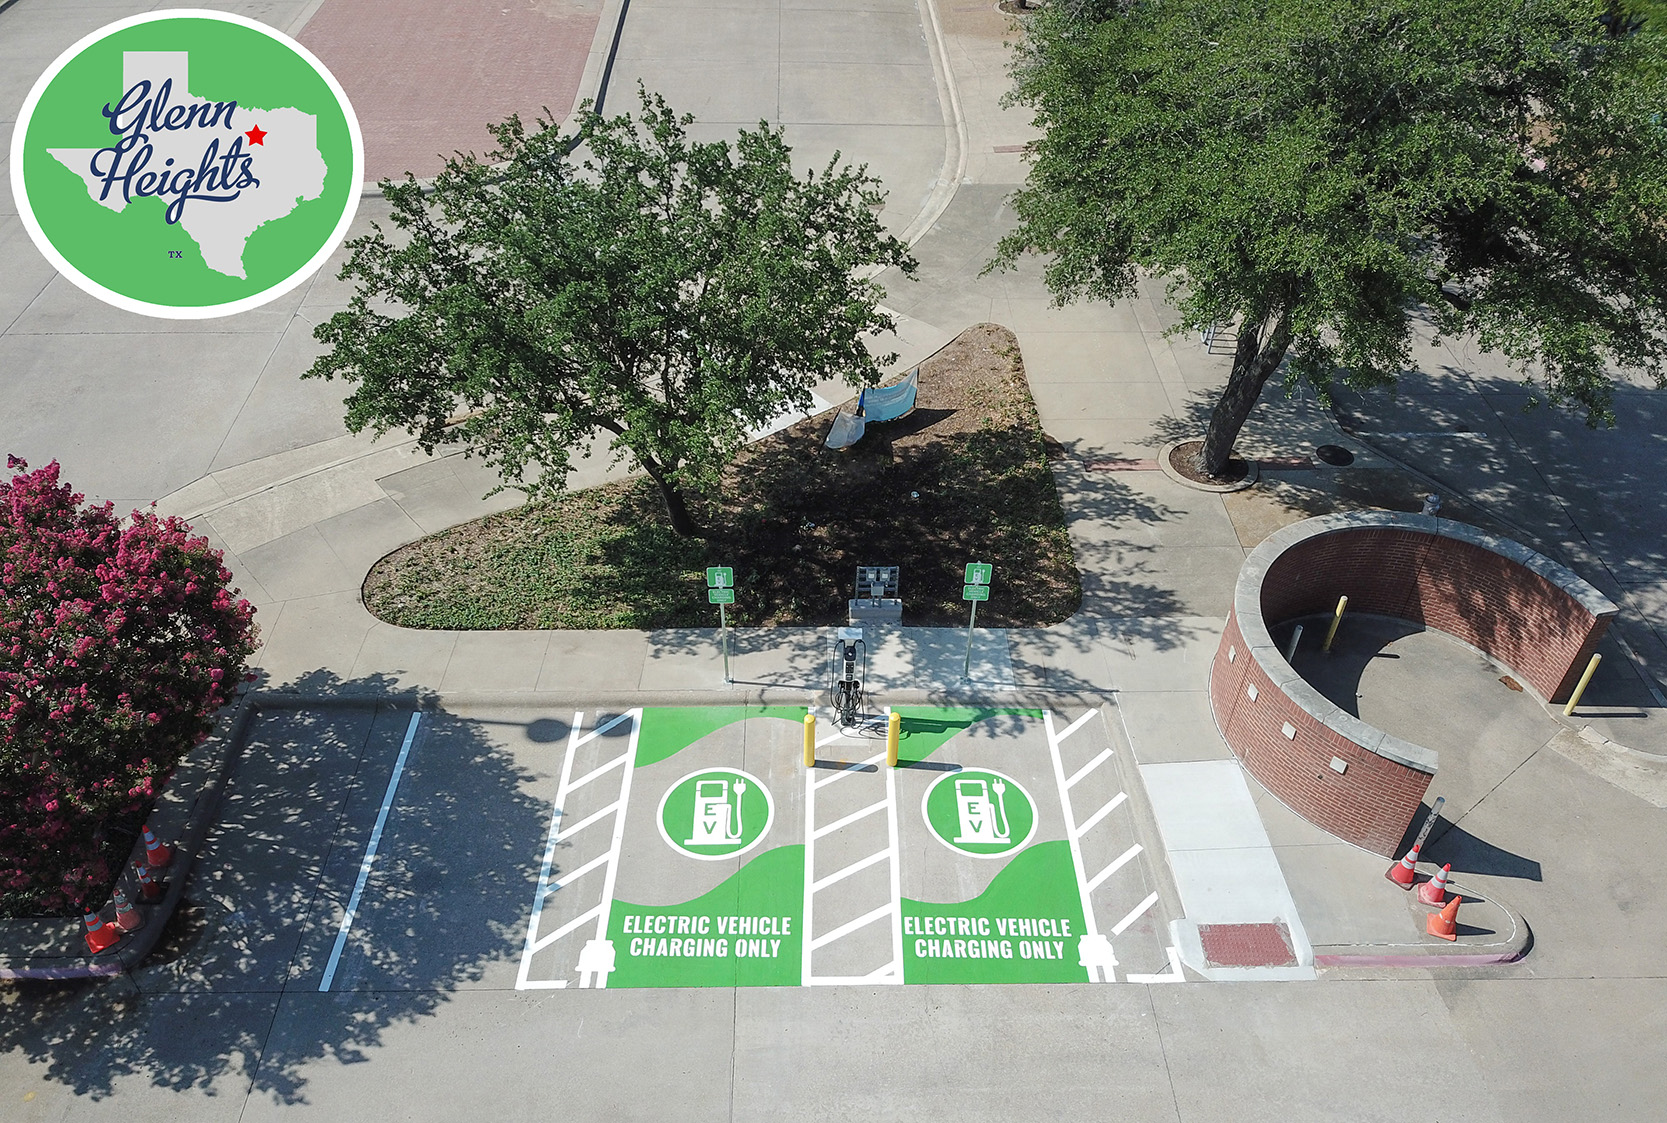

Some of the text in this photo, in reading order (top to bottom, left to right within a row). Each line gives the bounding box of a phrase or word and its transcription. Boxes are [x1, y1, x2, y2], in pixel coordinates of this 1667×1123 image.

[623, 915, 792, 936] ELECTRIC VEHICLE
[903, 916, 1073, 937] ELECTRIC VEHICLE
[629, 937, 782, 958] CHARGING ONLY
[915, 938, 1064, 960] CHARGING ONLY
